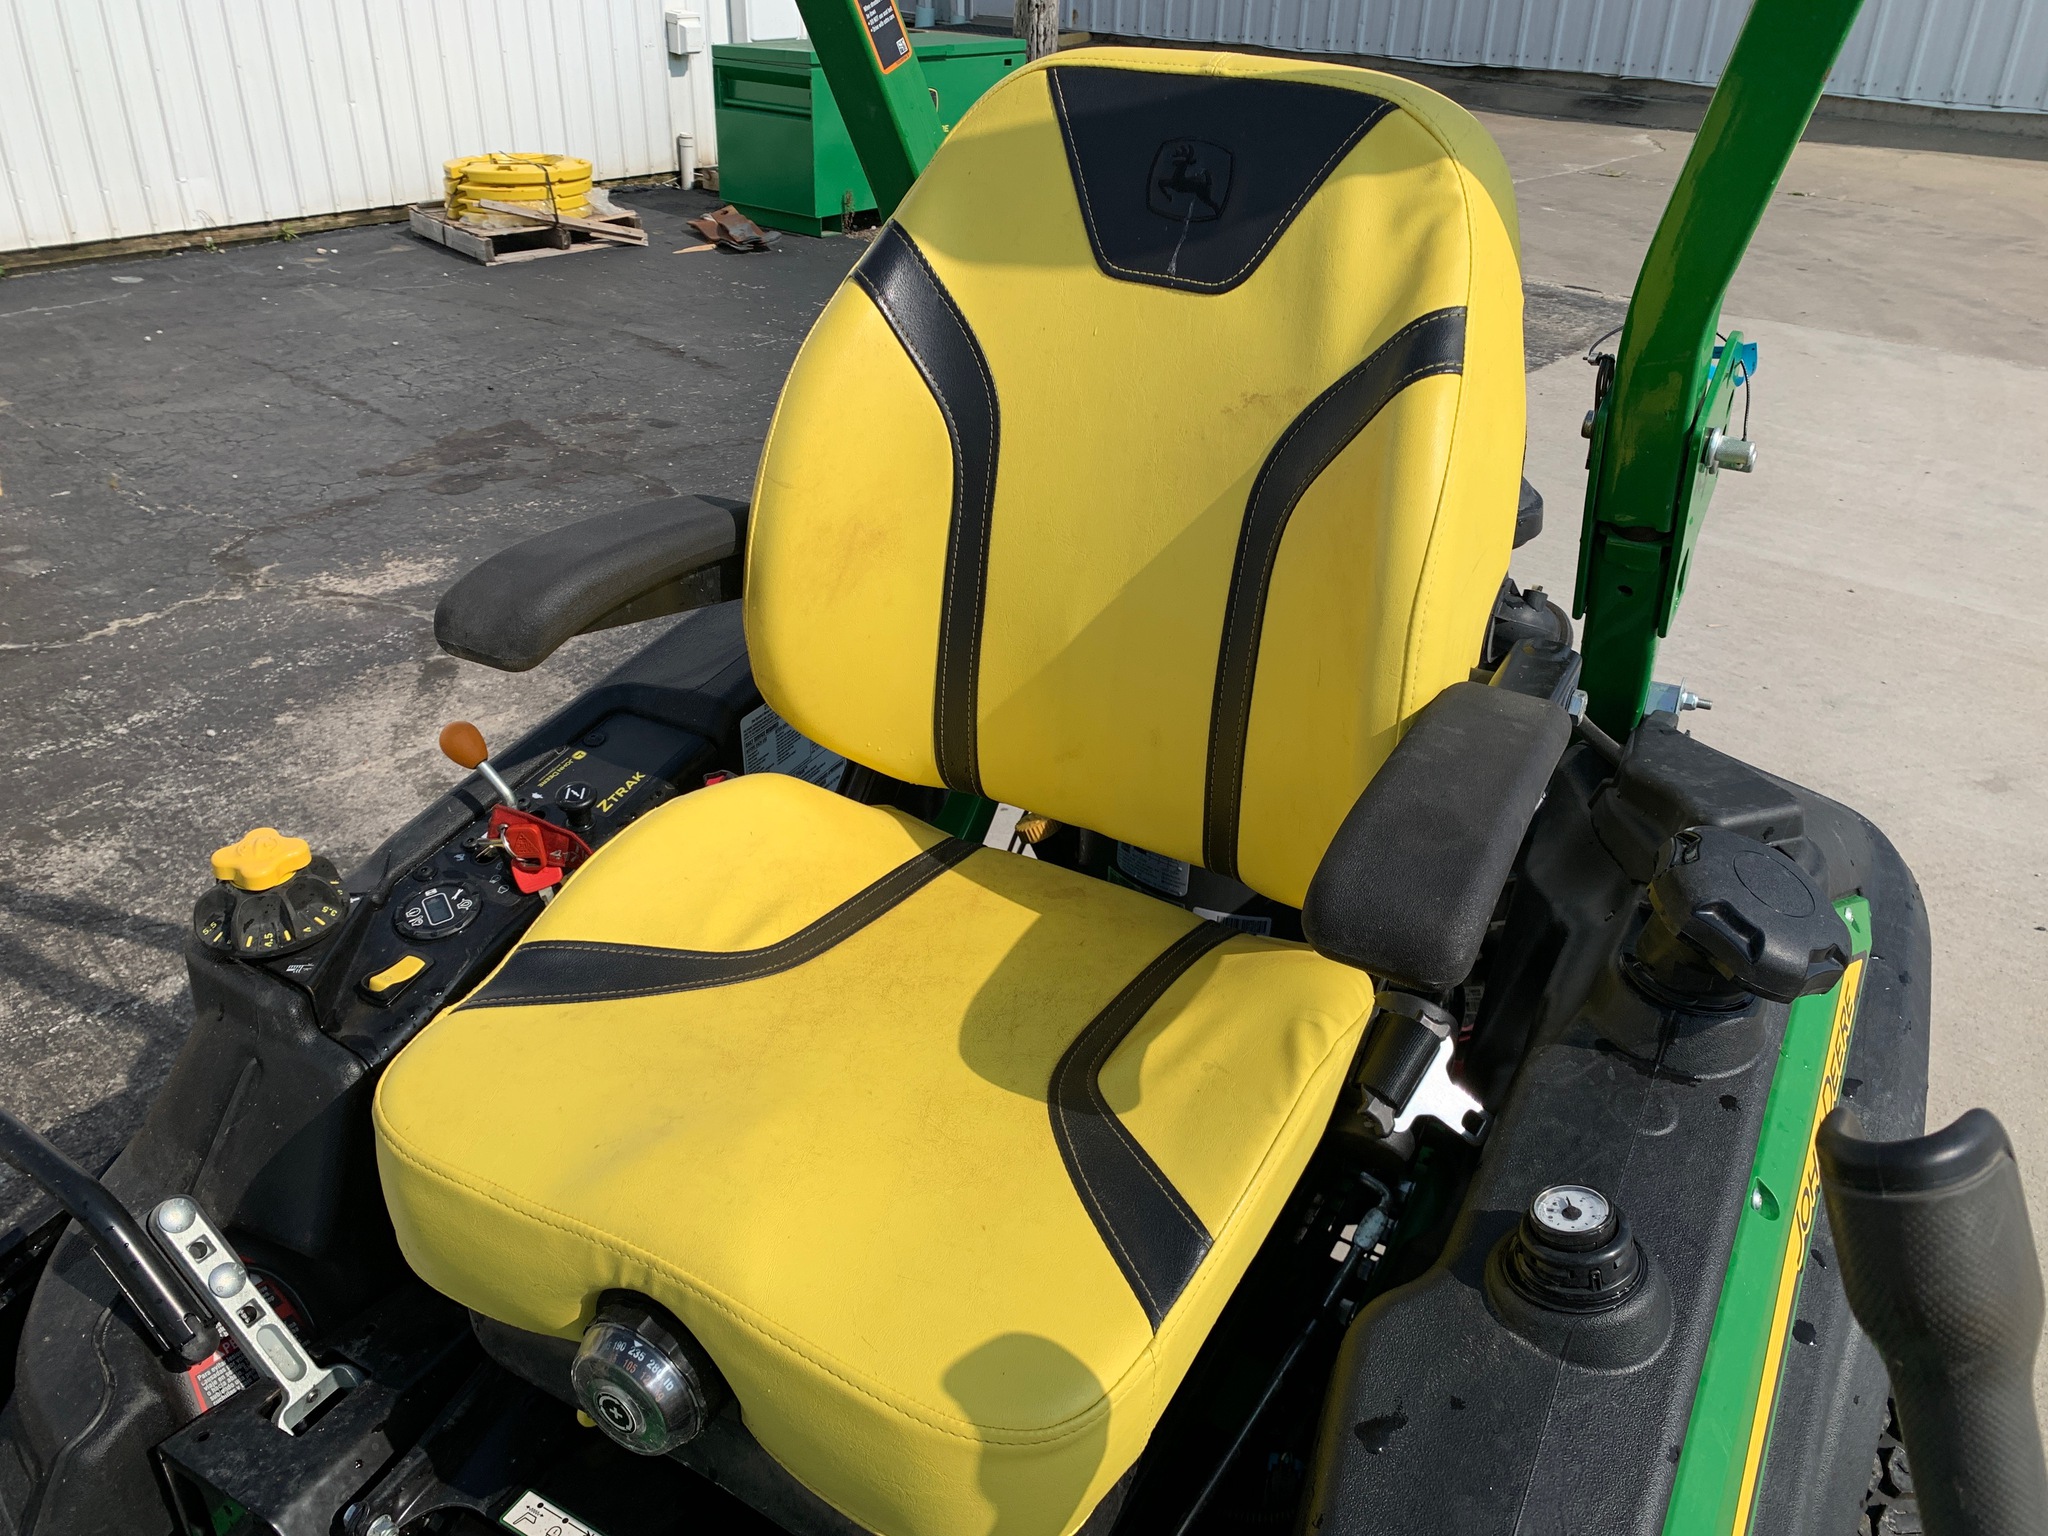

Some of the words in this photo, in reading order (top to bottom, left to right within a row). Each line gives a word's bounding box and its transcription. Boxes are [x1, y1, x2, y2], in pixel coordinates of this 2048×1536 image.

[557, 759, 574, 774] JOHN
[537, 769, 559, 788] DEERE
[596, 771, 647, 813] ZTRAK
[321, 905, 338, 918] 3.5
[202, 921, 218, 936] 5.5
[1796, 1135, 1822, 1272] JOH
[1822, 980, 1855, 1115] DEERE
[197, 1370, 211, 1381] Para
[211, 1360, 228, 1373] evitar
[613, 1340, 627, 1352] 190
[627, 1345, 647, 1362] 235
[663, 1377, 674, 1392] lb
[622, 1359, 638, 1374] 105
[203, 1379, 219, 1391] viaje
[218, 1374, 226, 1382] en
[210, 1380, 227, 1394] hacia
